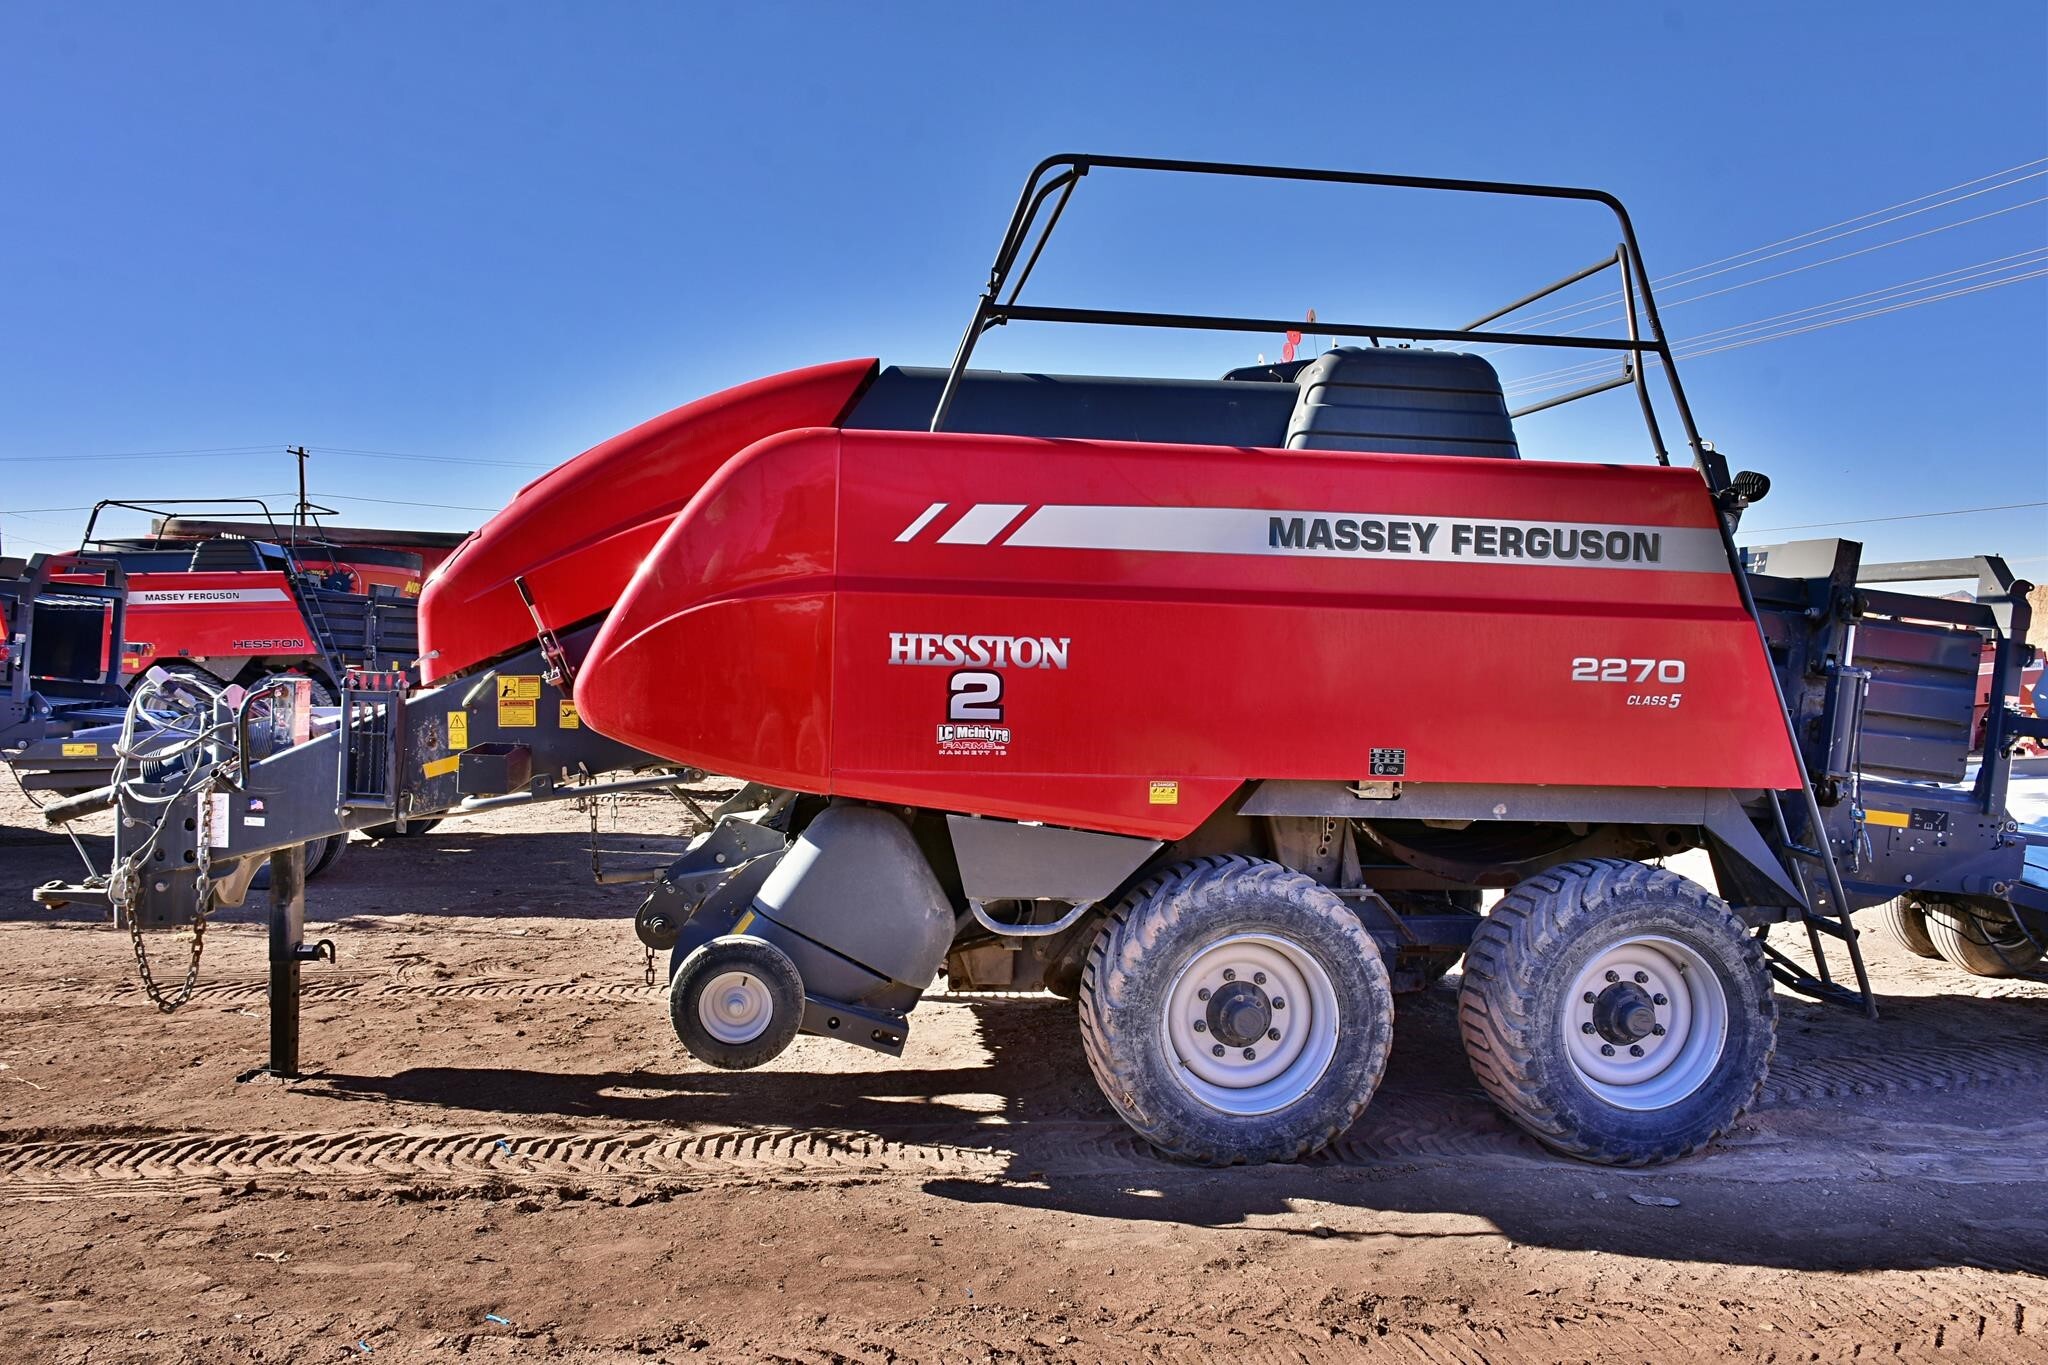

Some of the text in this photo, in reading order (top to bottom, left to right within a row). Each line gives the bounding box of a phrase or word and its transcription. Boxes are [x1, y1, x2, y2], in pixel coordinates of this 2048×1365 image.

[1269, 517, 1661, 564] MASSEY FERGUSON
[145, 592, 240, 601] MASSEY FERGUSON
[233, 639, 304, 649] HESSTON
[888, 632, 1071, 669] HESSTON
[1572, 657, 1685, 683] 2270
[949, 671, 1002, 721] 2
[1627, 693, 1682, 709] CLASS 5
[938, 725, 1010, 743] LC McIntyre
[943, 741, 995, 750] FARMS
